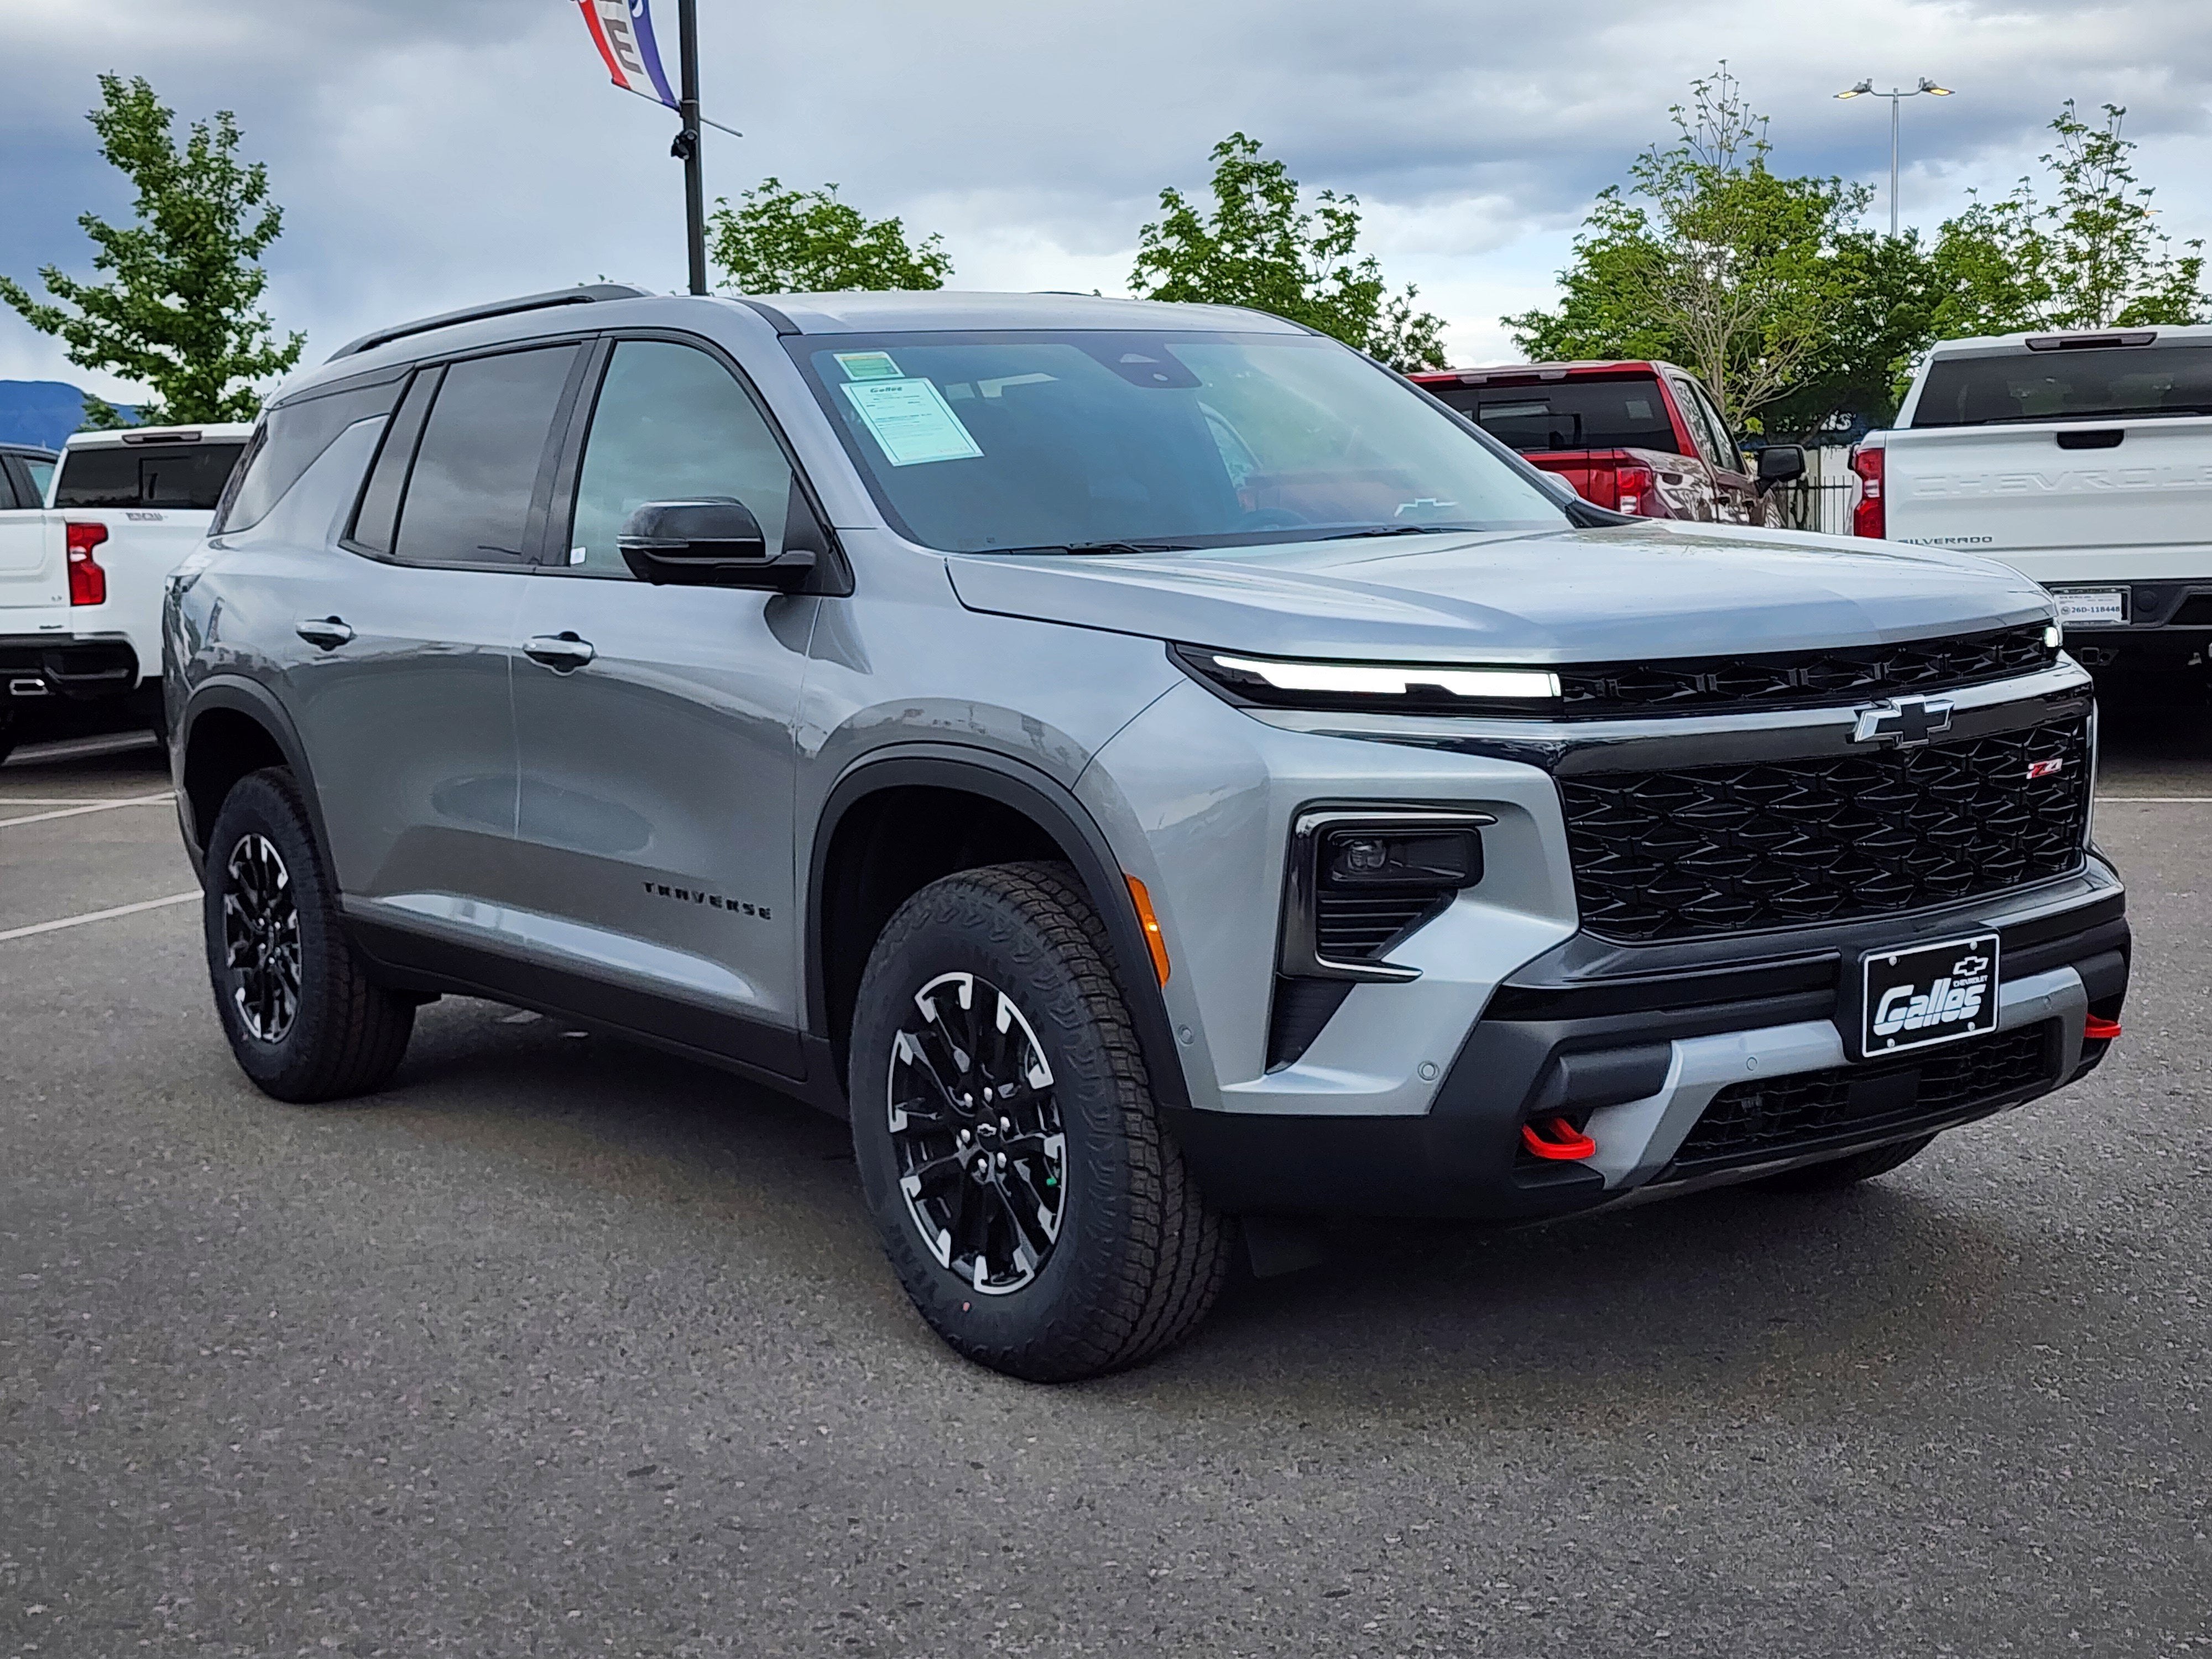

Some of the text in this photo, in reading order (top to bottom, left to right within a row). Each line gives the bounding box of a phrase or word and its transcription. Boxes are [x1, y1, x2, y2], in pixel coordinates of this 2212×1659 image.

[598, 0, 644, 75] E
[641, 881, 771, 920] TRAVERSE
[1872, 978, 1986, 1036] Galles
